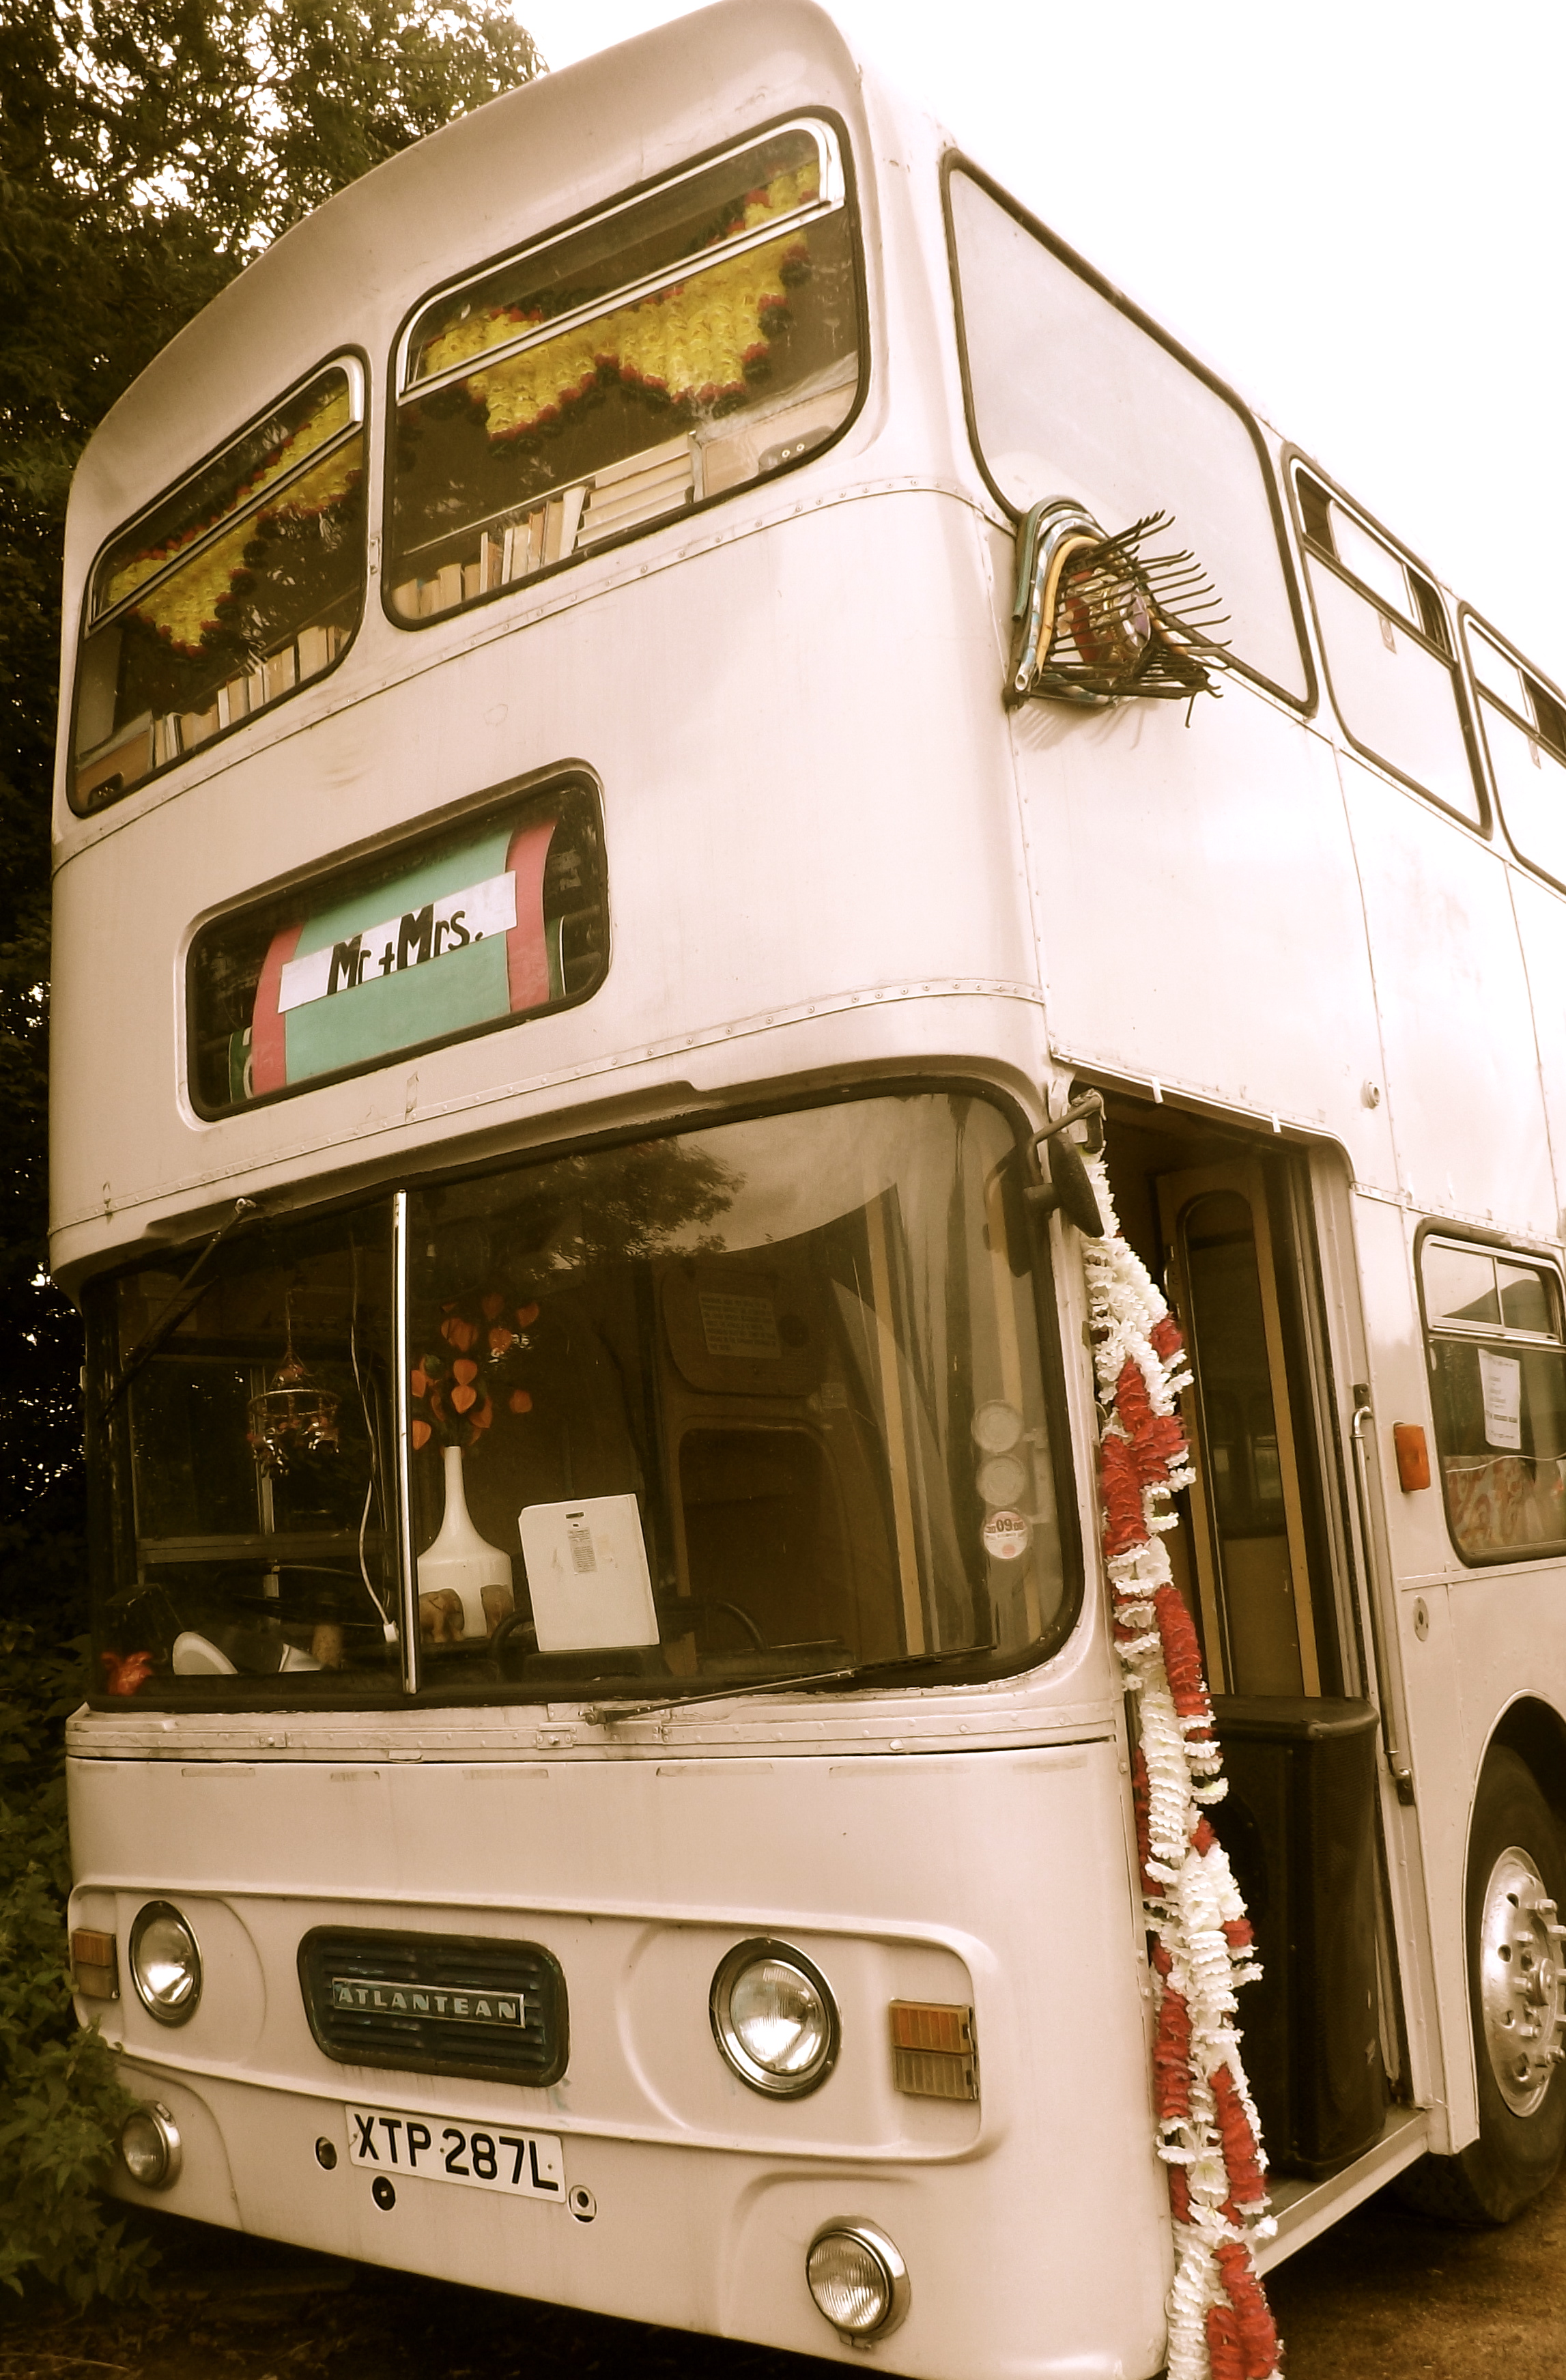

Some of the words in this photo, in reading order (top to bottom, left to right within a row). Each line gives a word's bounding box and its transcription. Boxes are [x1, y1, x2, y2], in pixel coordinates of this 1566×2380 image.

[327, 933, 372, 995] Mr
[397, 903, 483, 970] Mrs.
[997, 1518, 1012, 1531] 09
[339, 1987, 516, 2019] ATLANTEAN
[354, 2114, 431, 2167] XTP
[443, 2128, 558, 2191] 287L
